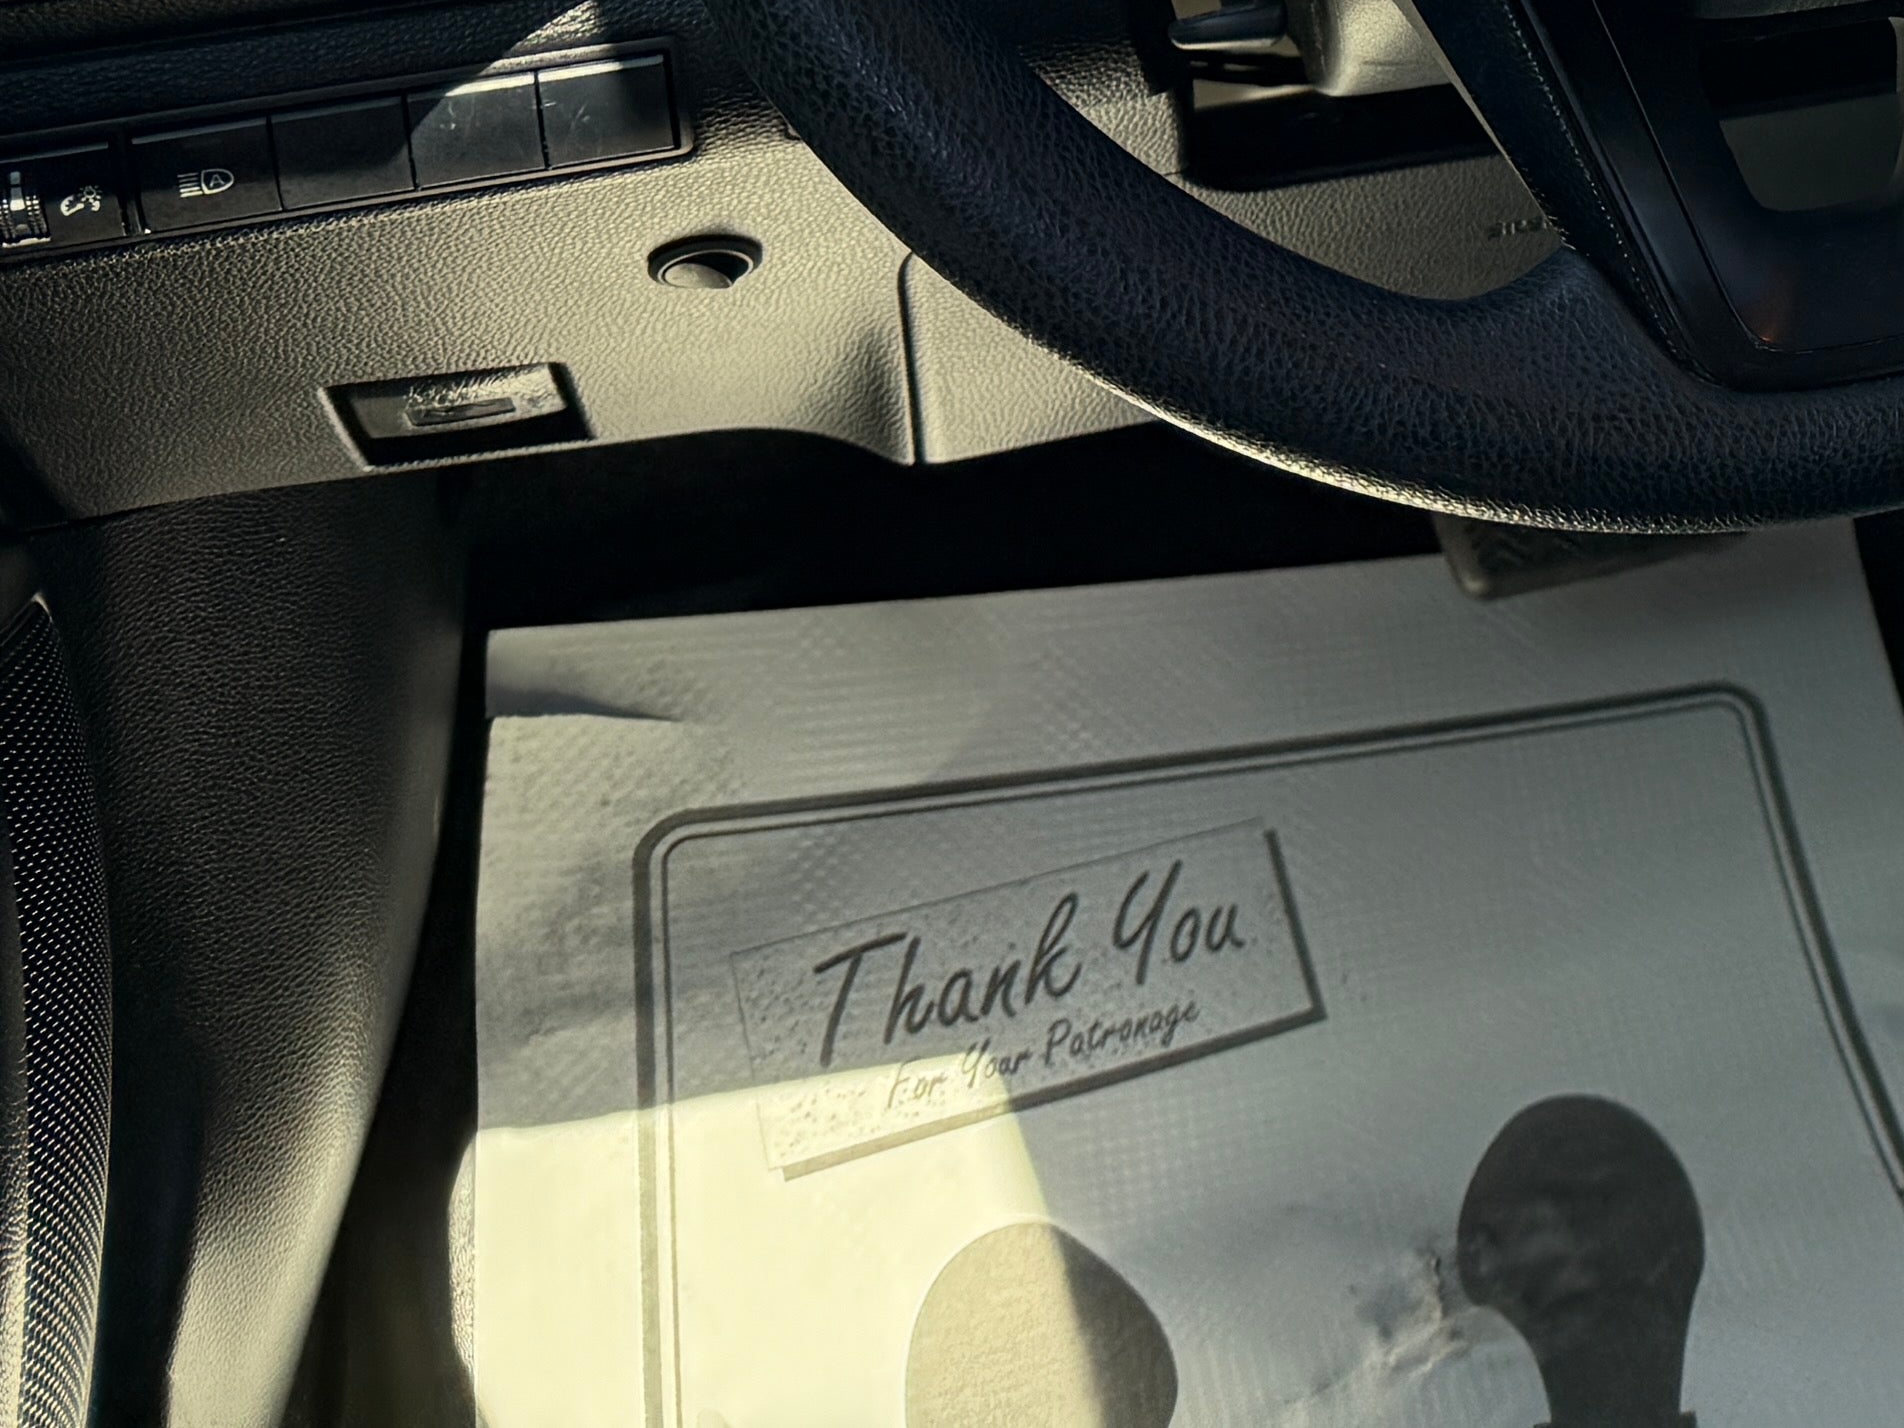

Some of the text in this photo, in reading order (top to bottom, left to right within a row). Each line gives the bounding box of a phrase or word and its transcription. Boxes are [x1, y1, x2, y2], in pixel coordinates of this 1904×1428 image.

[813, 859, 1246, 1068] Thank You
[884, 999, 1201, 1111] For Your Patronage
